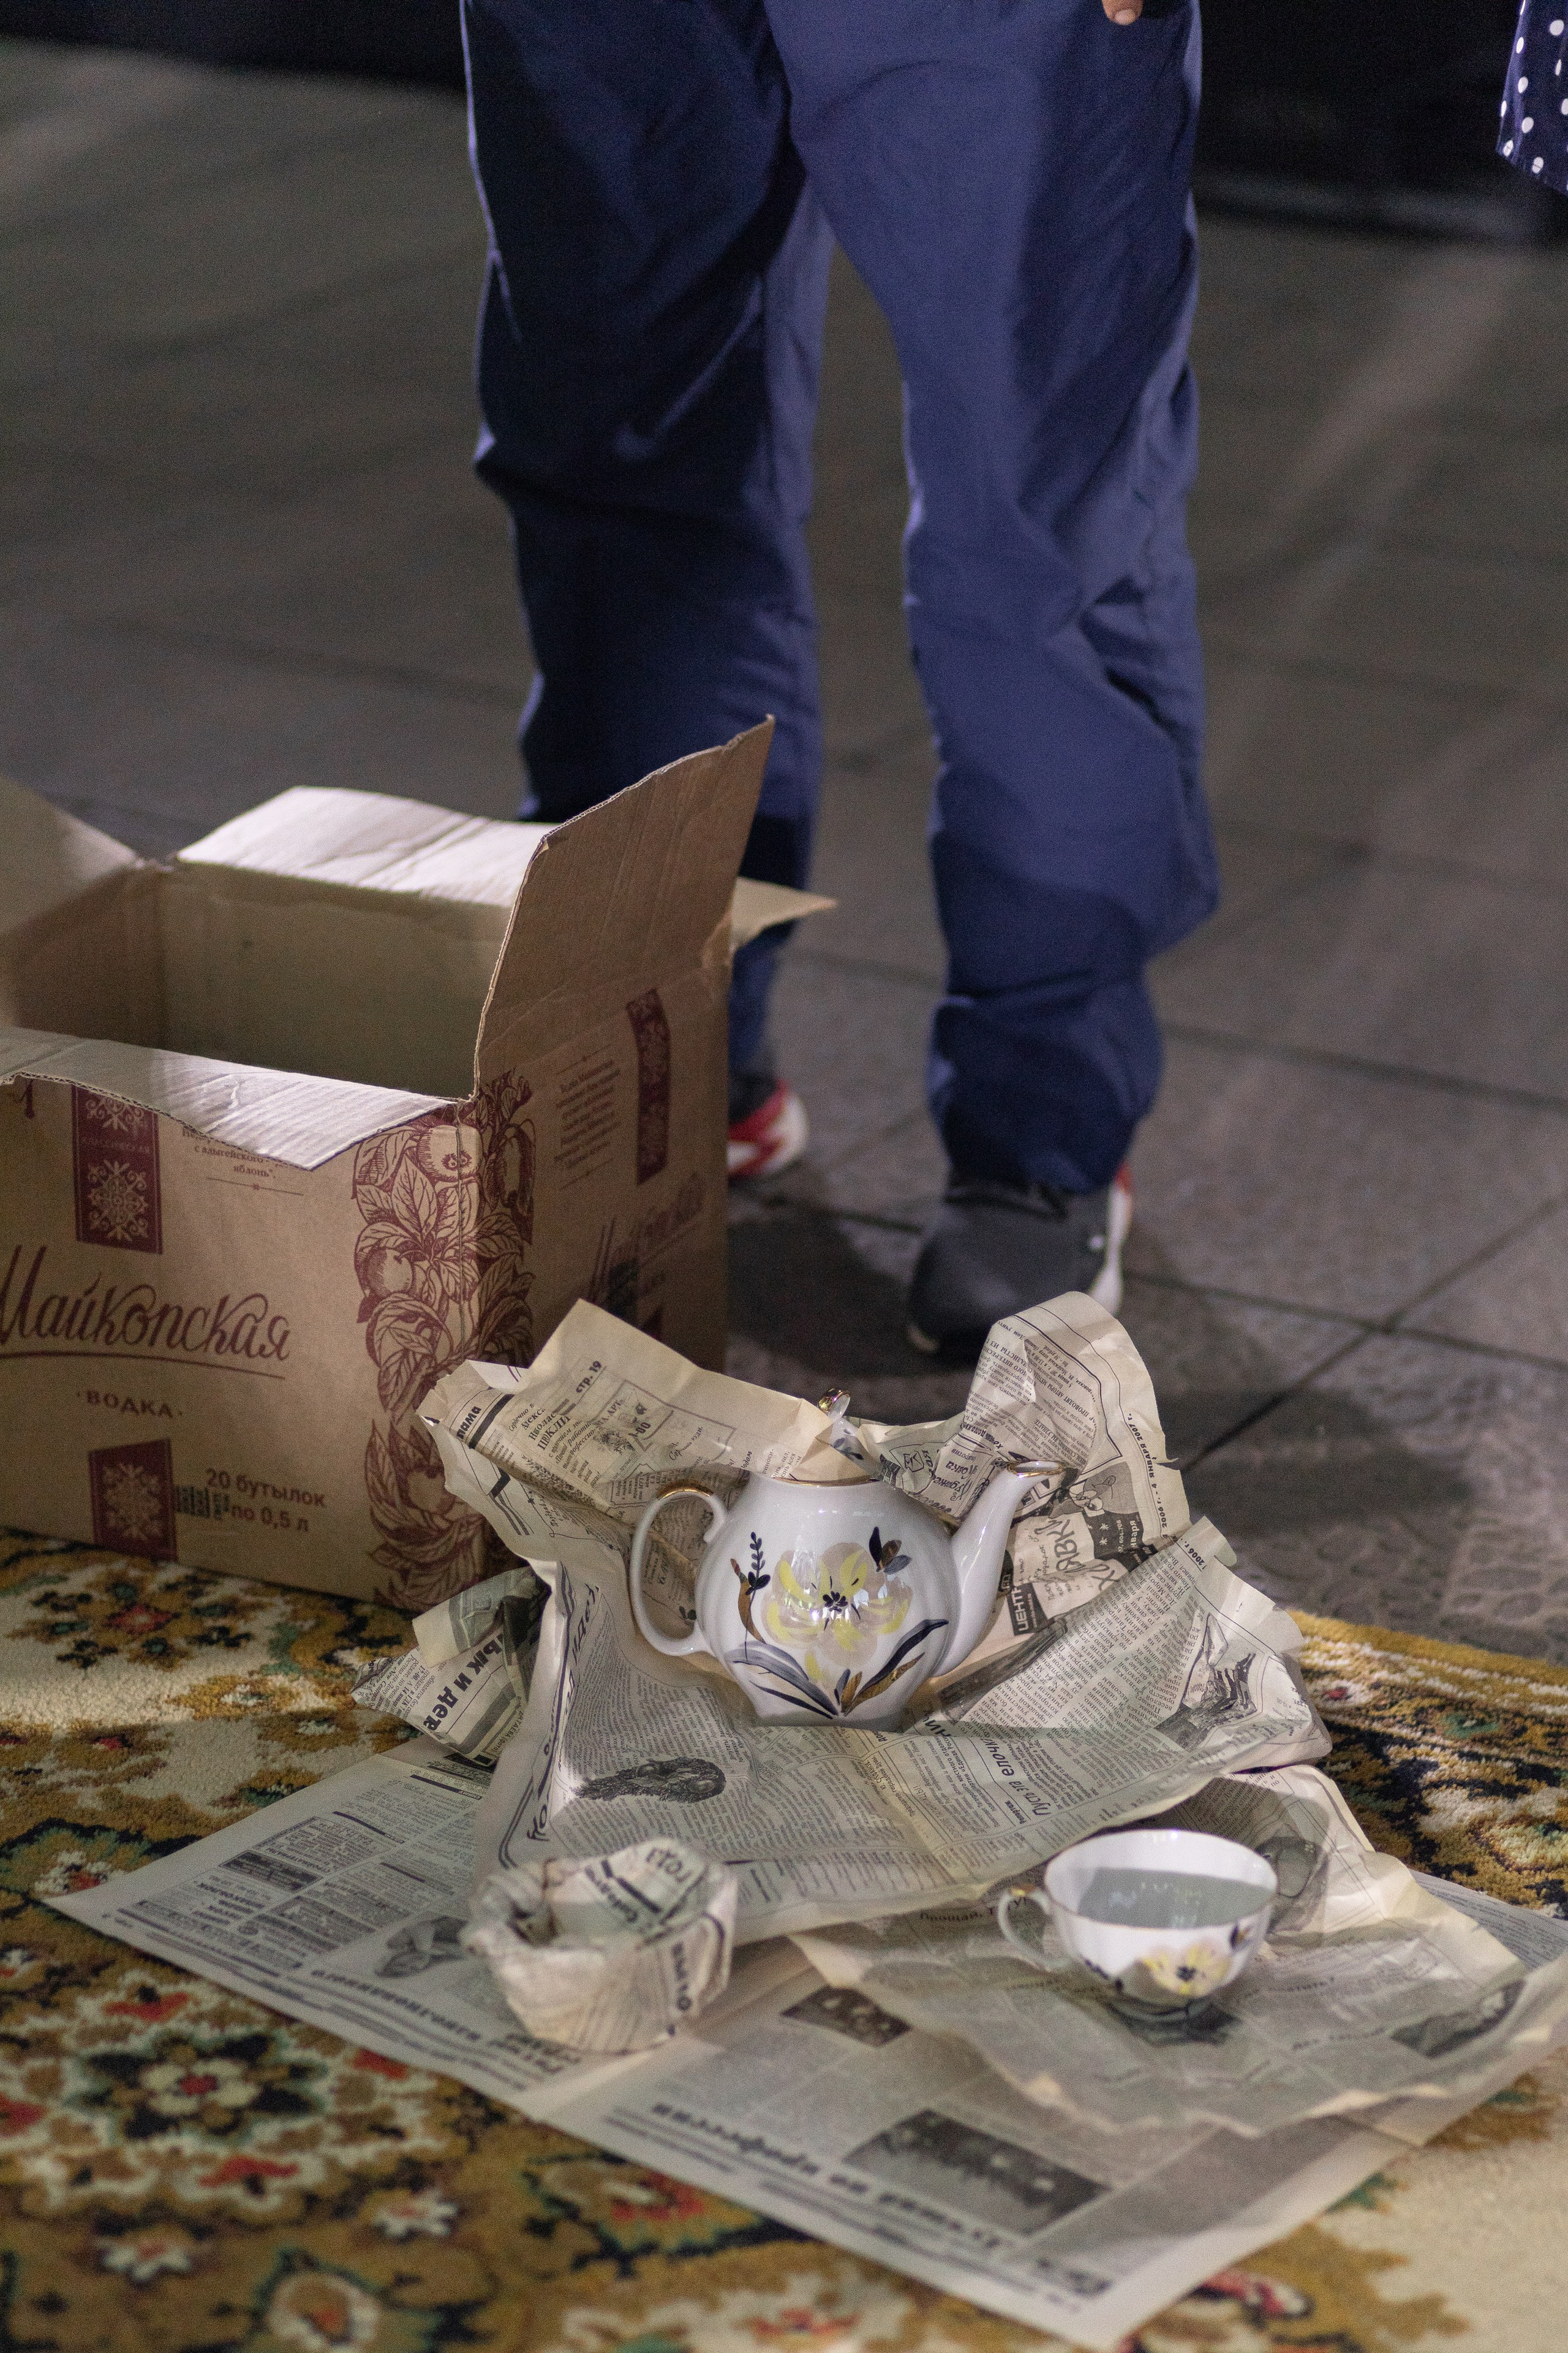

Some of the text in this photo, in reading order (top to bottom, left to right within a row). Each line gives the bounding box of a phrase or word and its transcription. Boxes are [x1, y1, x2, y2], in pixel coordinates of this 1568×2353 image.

[575, 1360, 602, 1394] стр. 19
[86, 1390, 174, 1419] ВОДКА
[1062, 1396, 1089, 1418] ПРОВОДЯТ
[1128, 1423, 1143, 1441] 2007
[1139, 1442, 1155, 1478] ЯНВАРЯ
[203, 1468, 328, 1509] 20 бутылок
[230, 1504, 310, 1533] по 0,5 л
[1158, 1506, 1167, 1528] 2006
[1185, 1546, 1206, 1567] 2006
[1156, 1565, 1186, 1596] Не хватает
[1163, 1581, 1183, 1601] другие
[1170, 1568, 1193, 1591] Нового
[1129, 1600, 1148, 1618] сияли
[1140, 1600, 1162, 1620] гляжу,
[1143, 1592, 1167, 1616] многие,
[1144, 1584, 1172, 1612] Николай
[1163, 1592, 1178, 1607] Дед
[1117, 1598, 1151, 1631] мальчонку,
[1121, 1612, 1145, 1636] дянин,
[1095, 1631, 1115, 1650] Когда
[1117, 1641, 1128, 1651] но
[1125, 1627, 1139, 1641] мэр
[1078, 1643, 1106, 1670] принять
[1088, 1642, 1112, 1666] участие
[1091, 1637, 1117, 1661] не было
[380, 1653, 417, 1698] Ростова-на-Дону
[410, 1664, 426, 1682] 17-00.
[1050, 1657, 1084, 1690] ми артистов
[1063, 1660, 1089, 1685] водились
[1064, 1650, 1096, 1680] конкурсы.
[1081, 1656, 1100, 1675] чем от
[1116, 1660, 1144, 1686] духовой
[1126, 1659, 1150, 1682] одетые
[386, 1658, 421, 1701] редкие, но очень
[401, 1685, 410, 1694] 14
[412, 1669, 432, 1692] пройдет
[414, 1672, 437, 1701] обходятся
[451, 1672, 474, 1693] и
[1047, 1684, 1057, 1693] из
[1095, 1679, 1119, 1702] сильно
[989, 1689, 1009, 1709] боль-
[995, 1683, 1029, 1717] участники
[1001, 1680, 1049, 1726] городской само-
[1013, 1681, 1054, 1721] деятельности,
[1032, 1688, 1060, 1715] которых
[1038, 1684, 1064, 1710] умилили
[1059, 1685, 1074, 1701] сада
[980, 1697, 1001, 1720] гостей
[1081, 1694, 1106, 1721] Видимо,
[945, 1756, 965, 1783] местного
[949, 1749, 968, 1773] «Единая
[1008, 1778, 1028, 1799] эта
[1021, 1786, 1052, 1819] Пусть
